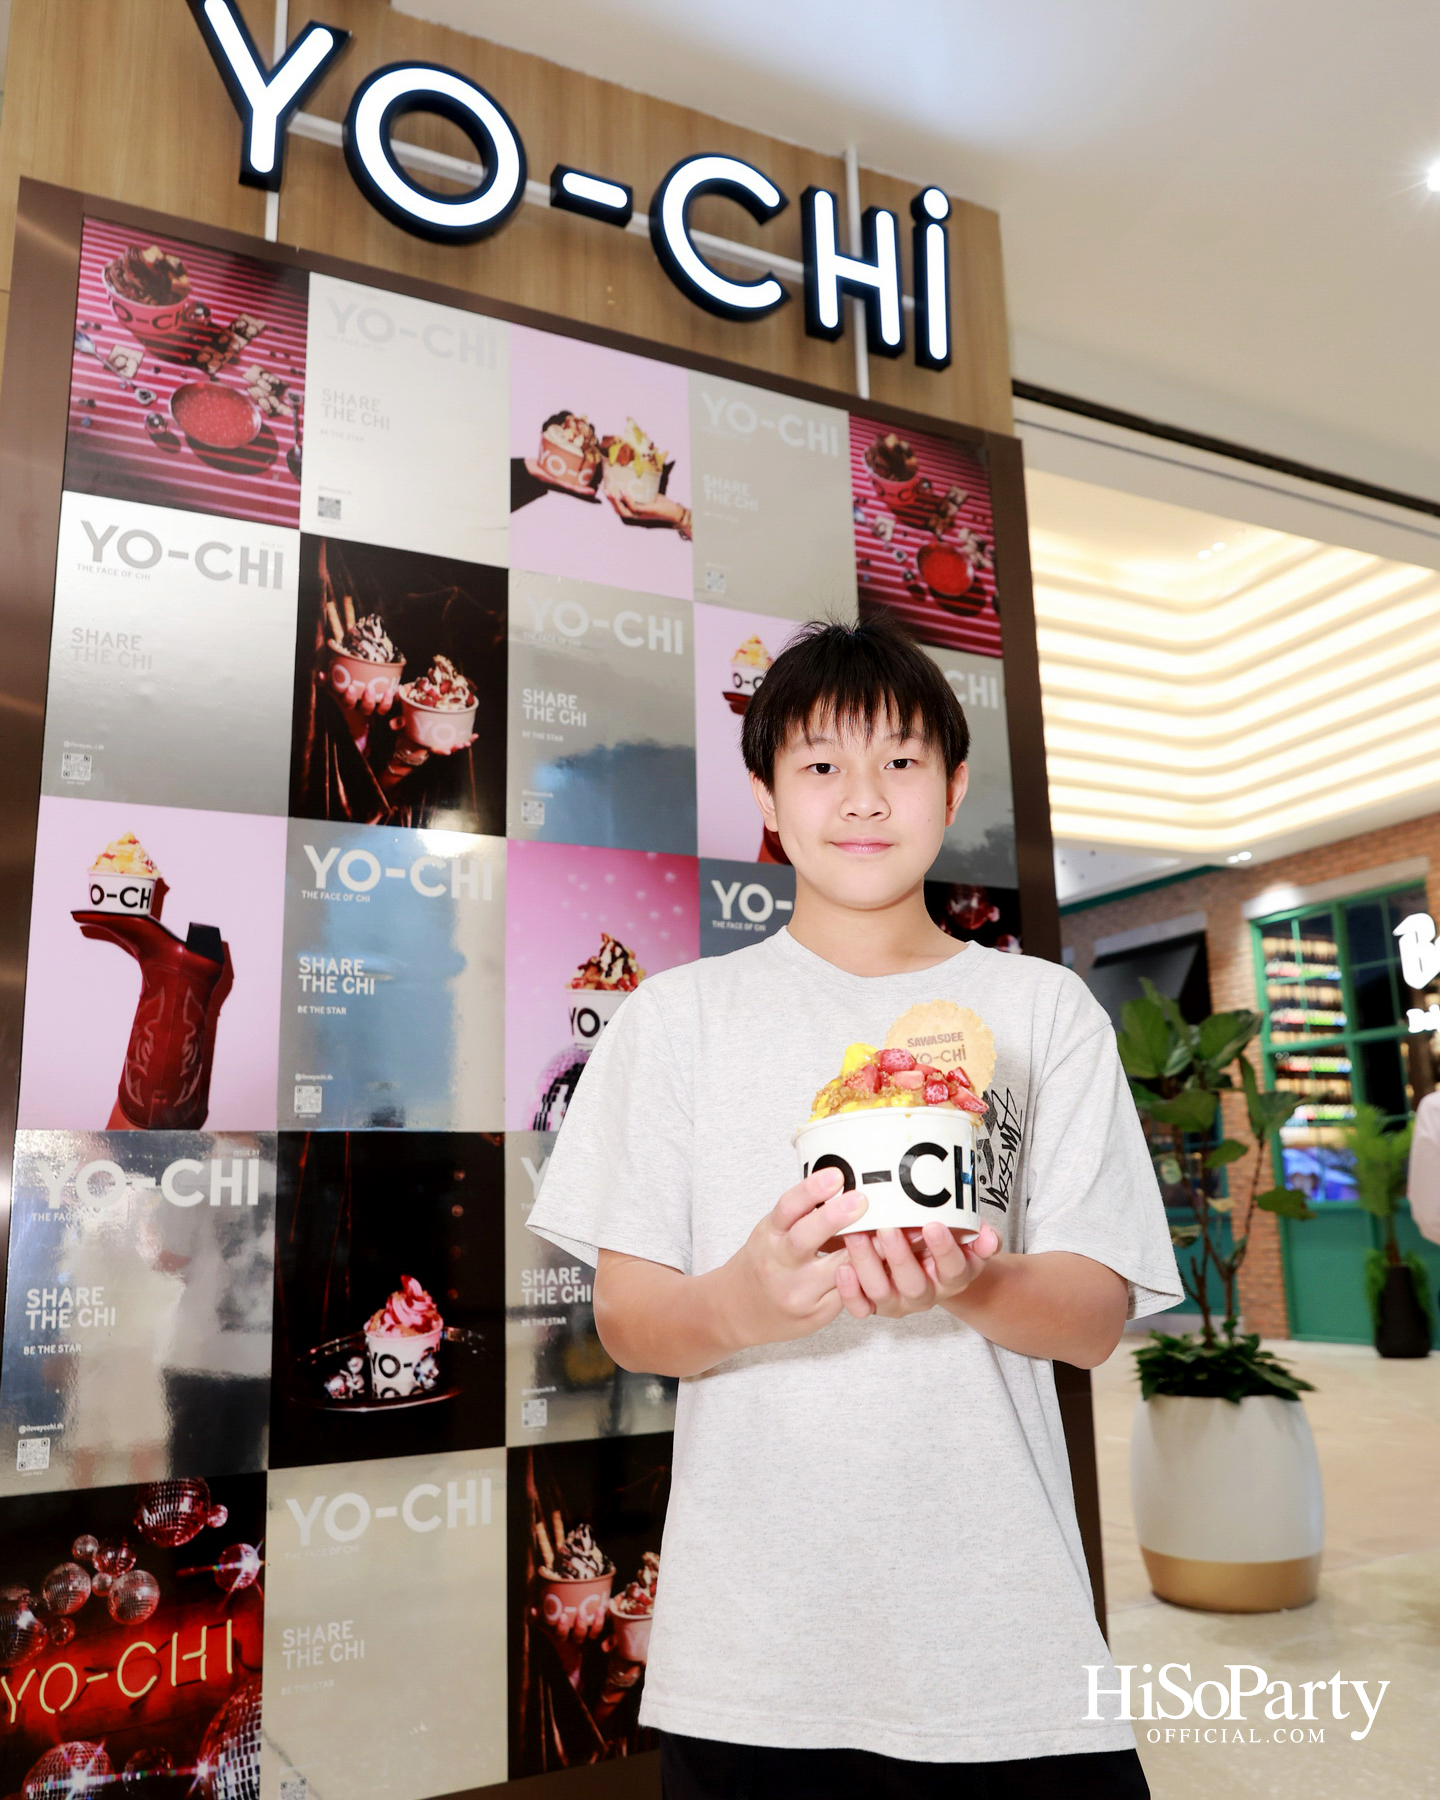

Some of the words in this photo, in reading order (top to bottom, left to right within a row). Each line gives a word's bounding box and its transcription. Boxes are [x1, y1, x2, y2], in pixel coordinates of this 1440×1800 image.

[325, 297, 497, 370] YO-CHI
[321, 387, 381, 413] SHARE
[320, 402, 357, 423] THE
[361, 411, 390, 431] CHI
[701, 391, 840, 458] YO-CHI
[80, 519, 284, 590] YO-CHI
[526, 593, 684, 655] YO-CHI
[71, 627, 142, 651] SHARE
[71, 645, 113, 665] THE
[118, 651, 152, 670] CHI
[521, 687, 579, 710] SHARE
[521, 704, 556, 723] THE
[558, 709, 588, 728] CHI
[303, 844, 493, 901] YO-CHI
[301, 889, 319, 900] THE
[320, 892, 341, 901] FACE
[342, 893, 354, 902] OF
[356, 894, 371, 903] CHI
[298, 956, 365, 977] SHARE
[298, 974, 338, 994] THE
[342, 977, 375, 996] CHI
[297, 1005, 308, 1014] BE
[309, 1006, 325, 1014] THE
[326, 1006, 347, 1015] STAR
[907, 1032, 965, 1048] SAWASDEE
[36, 1158, 260, 1210] YO-CHI
[32, 1211, 51, 1222] THE
[520, 1267, 582, 1286] SHARE
[26, 1286, 105, 1309] SHARE
[521, 1287, 558, 1305] THE
[560, 1285, 592, 1304] CHI
[25, 1308, 72, 1330] THE
[77, 1306, 117, 1328] CHI
[23, 1345, 36, 1356] BE
[37, 1345, 56, 1354] THE
[57, 1343, 82, 1354] STAR
[285, 1477, 492, 1547] YO-CHI
[282, 1619, 354, 1649] SHARE
[281, 1645, 325, 1670] THE
[329, 1639, 366, 1663] CHI
[1, 1619, 233, 1723] YO-CHI
